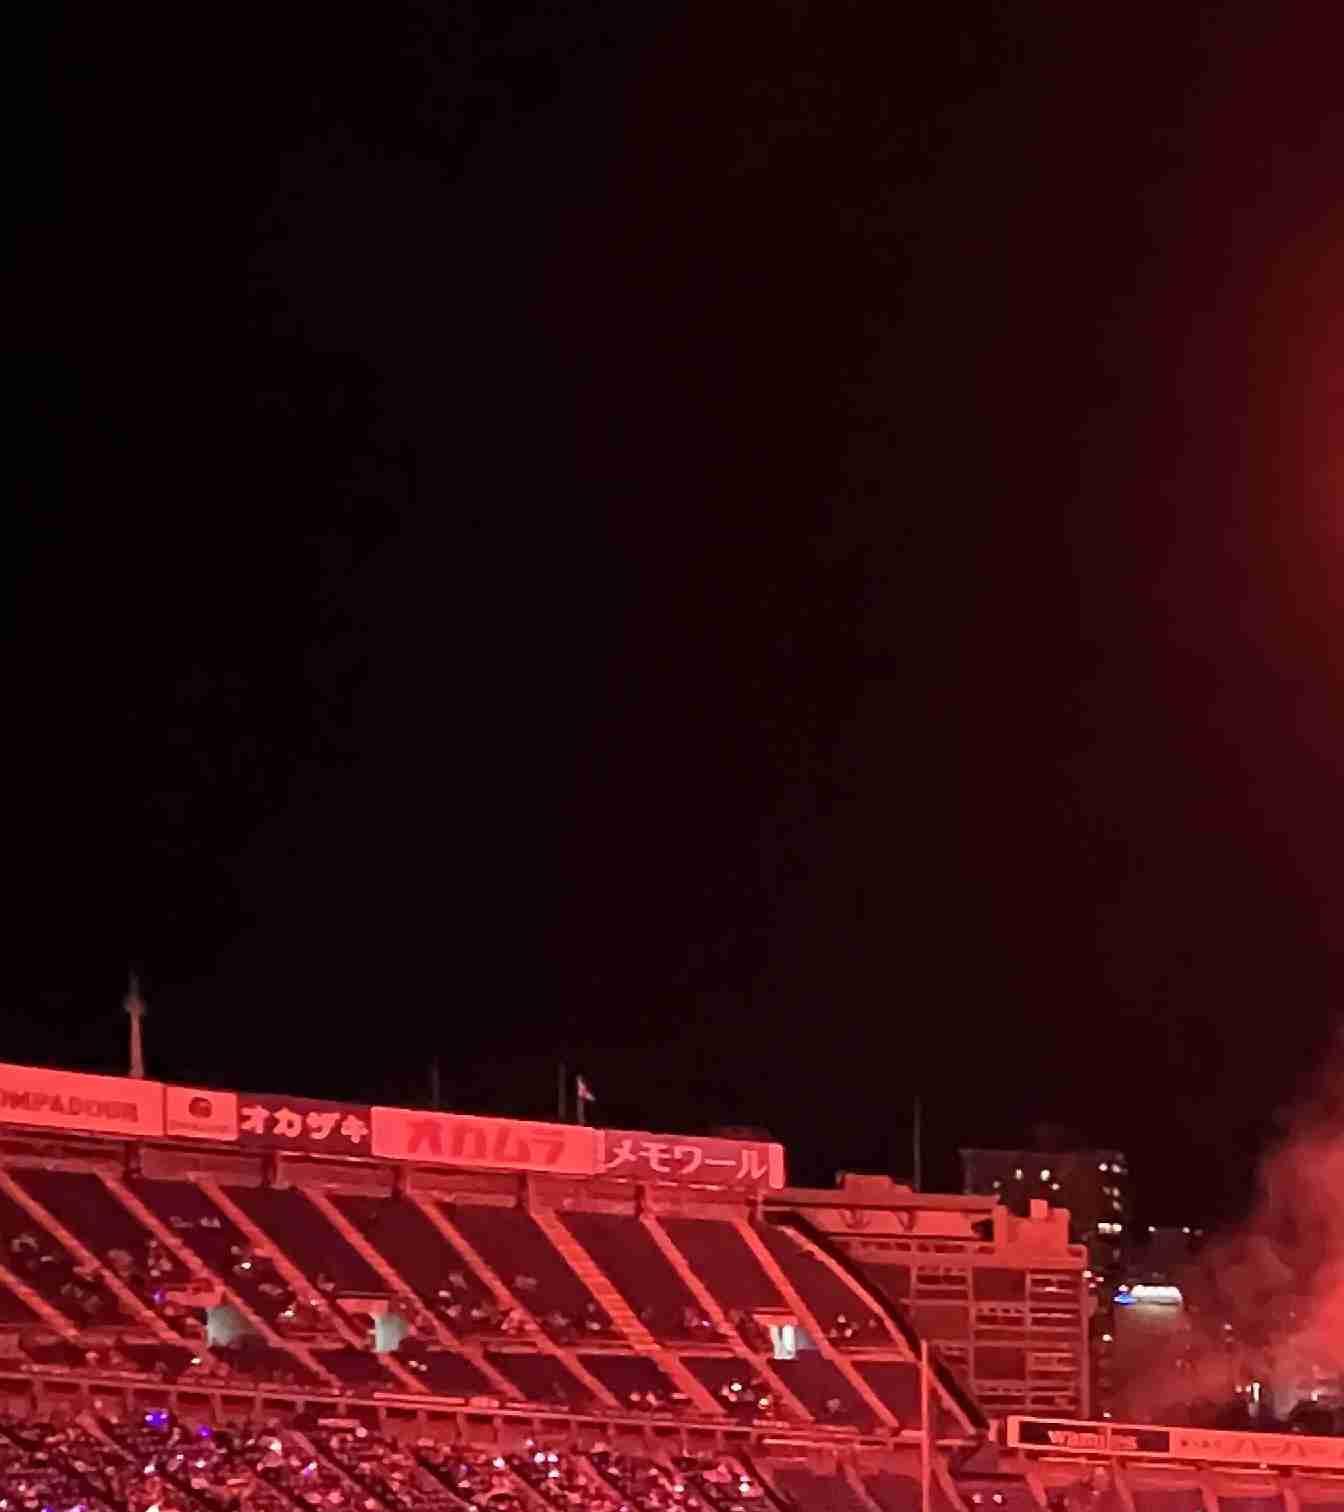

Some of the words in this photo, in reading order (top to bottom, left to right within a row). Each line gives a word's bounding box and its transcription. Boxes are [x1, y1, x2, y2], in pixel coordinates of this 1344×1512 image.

[238, 1105, 370, 1143] オカザキ
[406, 1117, 566, 1166] オカムラ
[606, 1138, 769, 1180] メモワール
